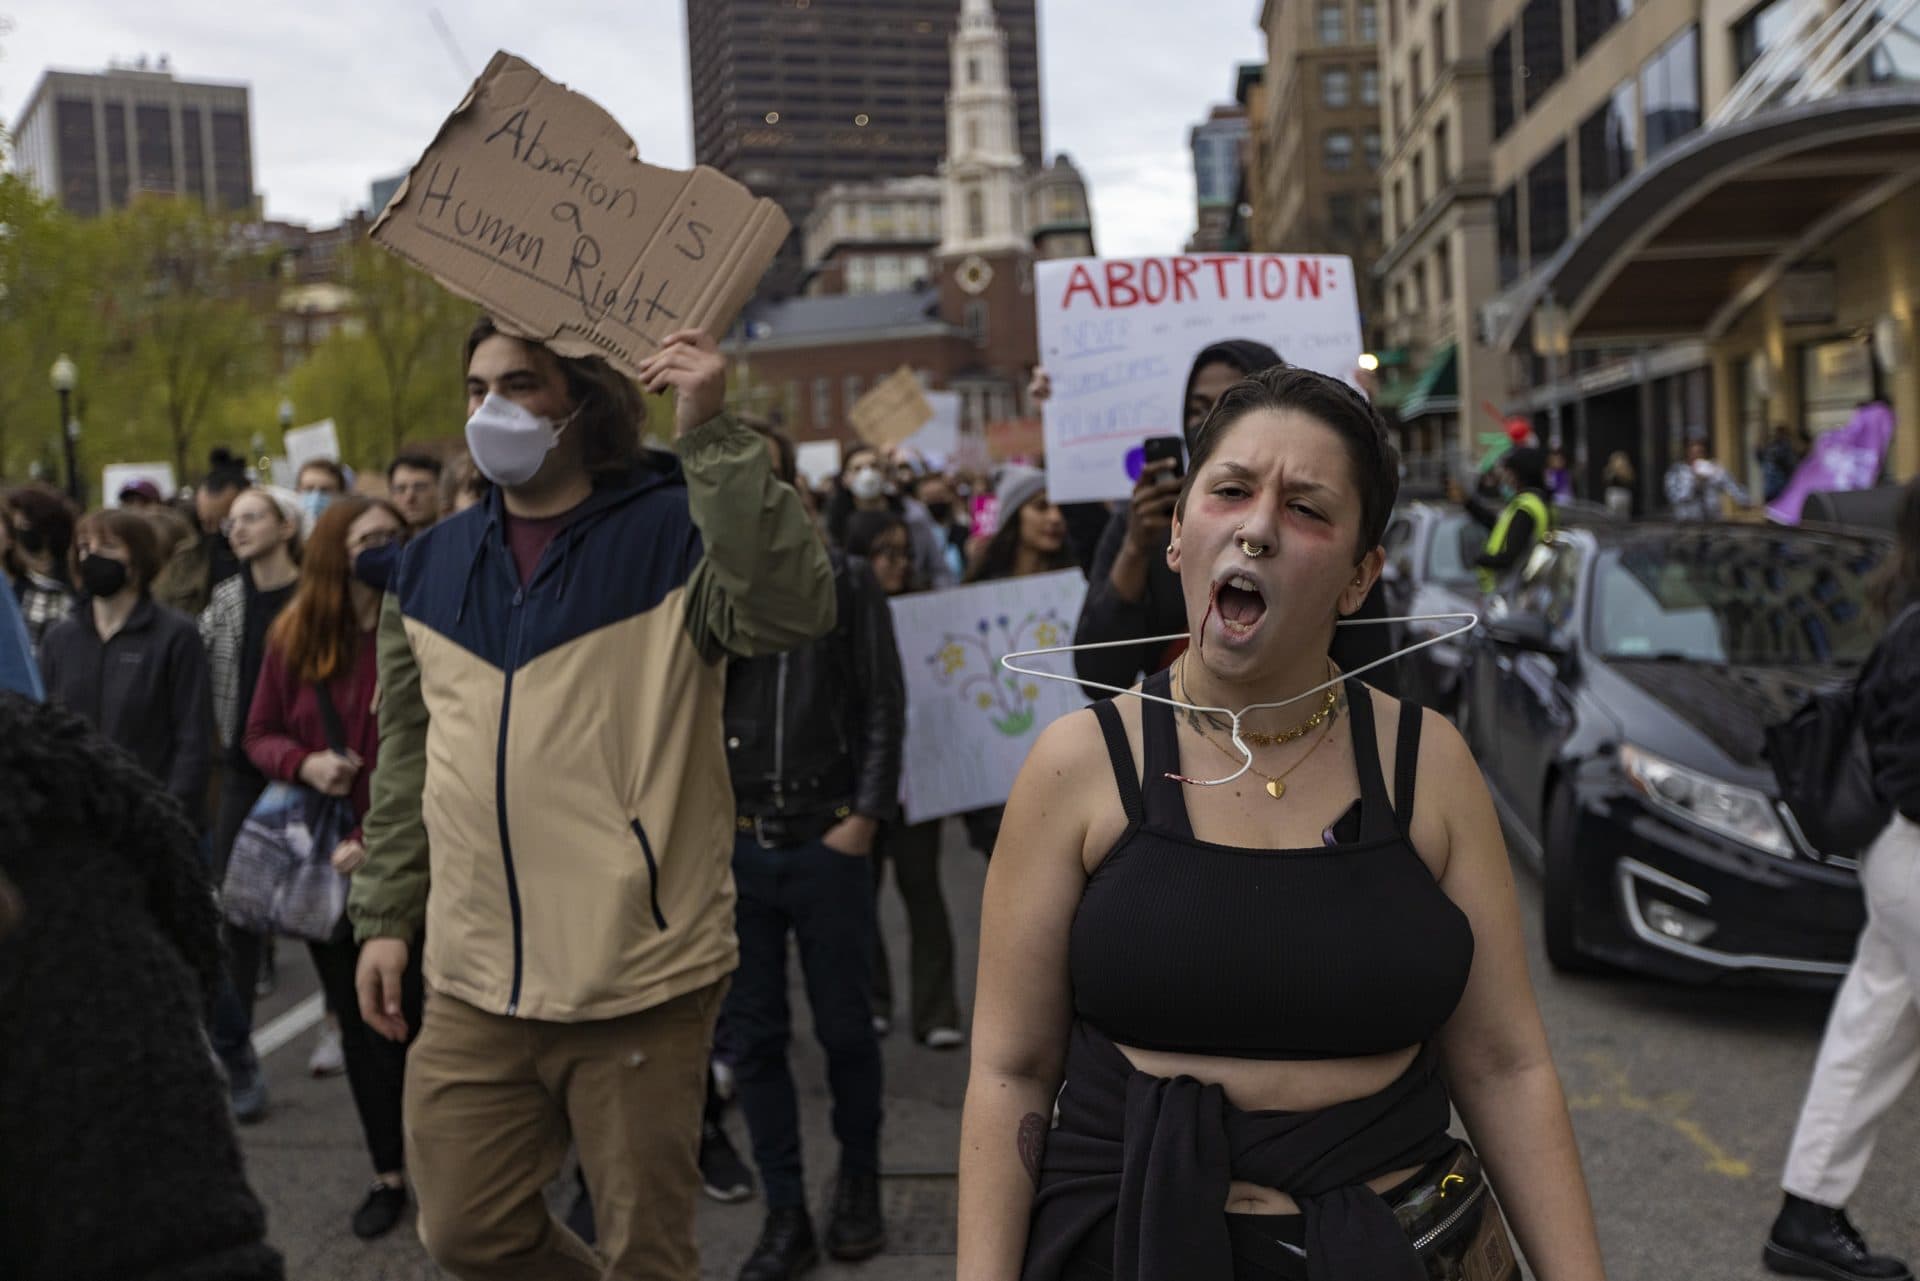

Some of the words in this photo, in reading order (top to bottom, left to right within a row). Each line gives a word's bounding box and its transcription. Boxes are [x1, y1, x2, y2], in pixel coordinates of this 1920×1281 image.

[485, 109, 638, 218] Abortion
[665, 200, 713, 261] is
[551, 202, 584, 233] a
[417, 162, 546, 270] Human
[564, 235, 680, 325] Right
[1061, 255, 1338, 310] ABORTION:
